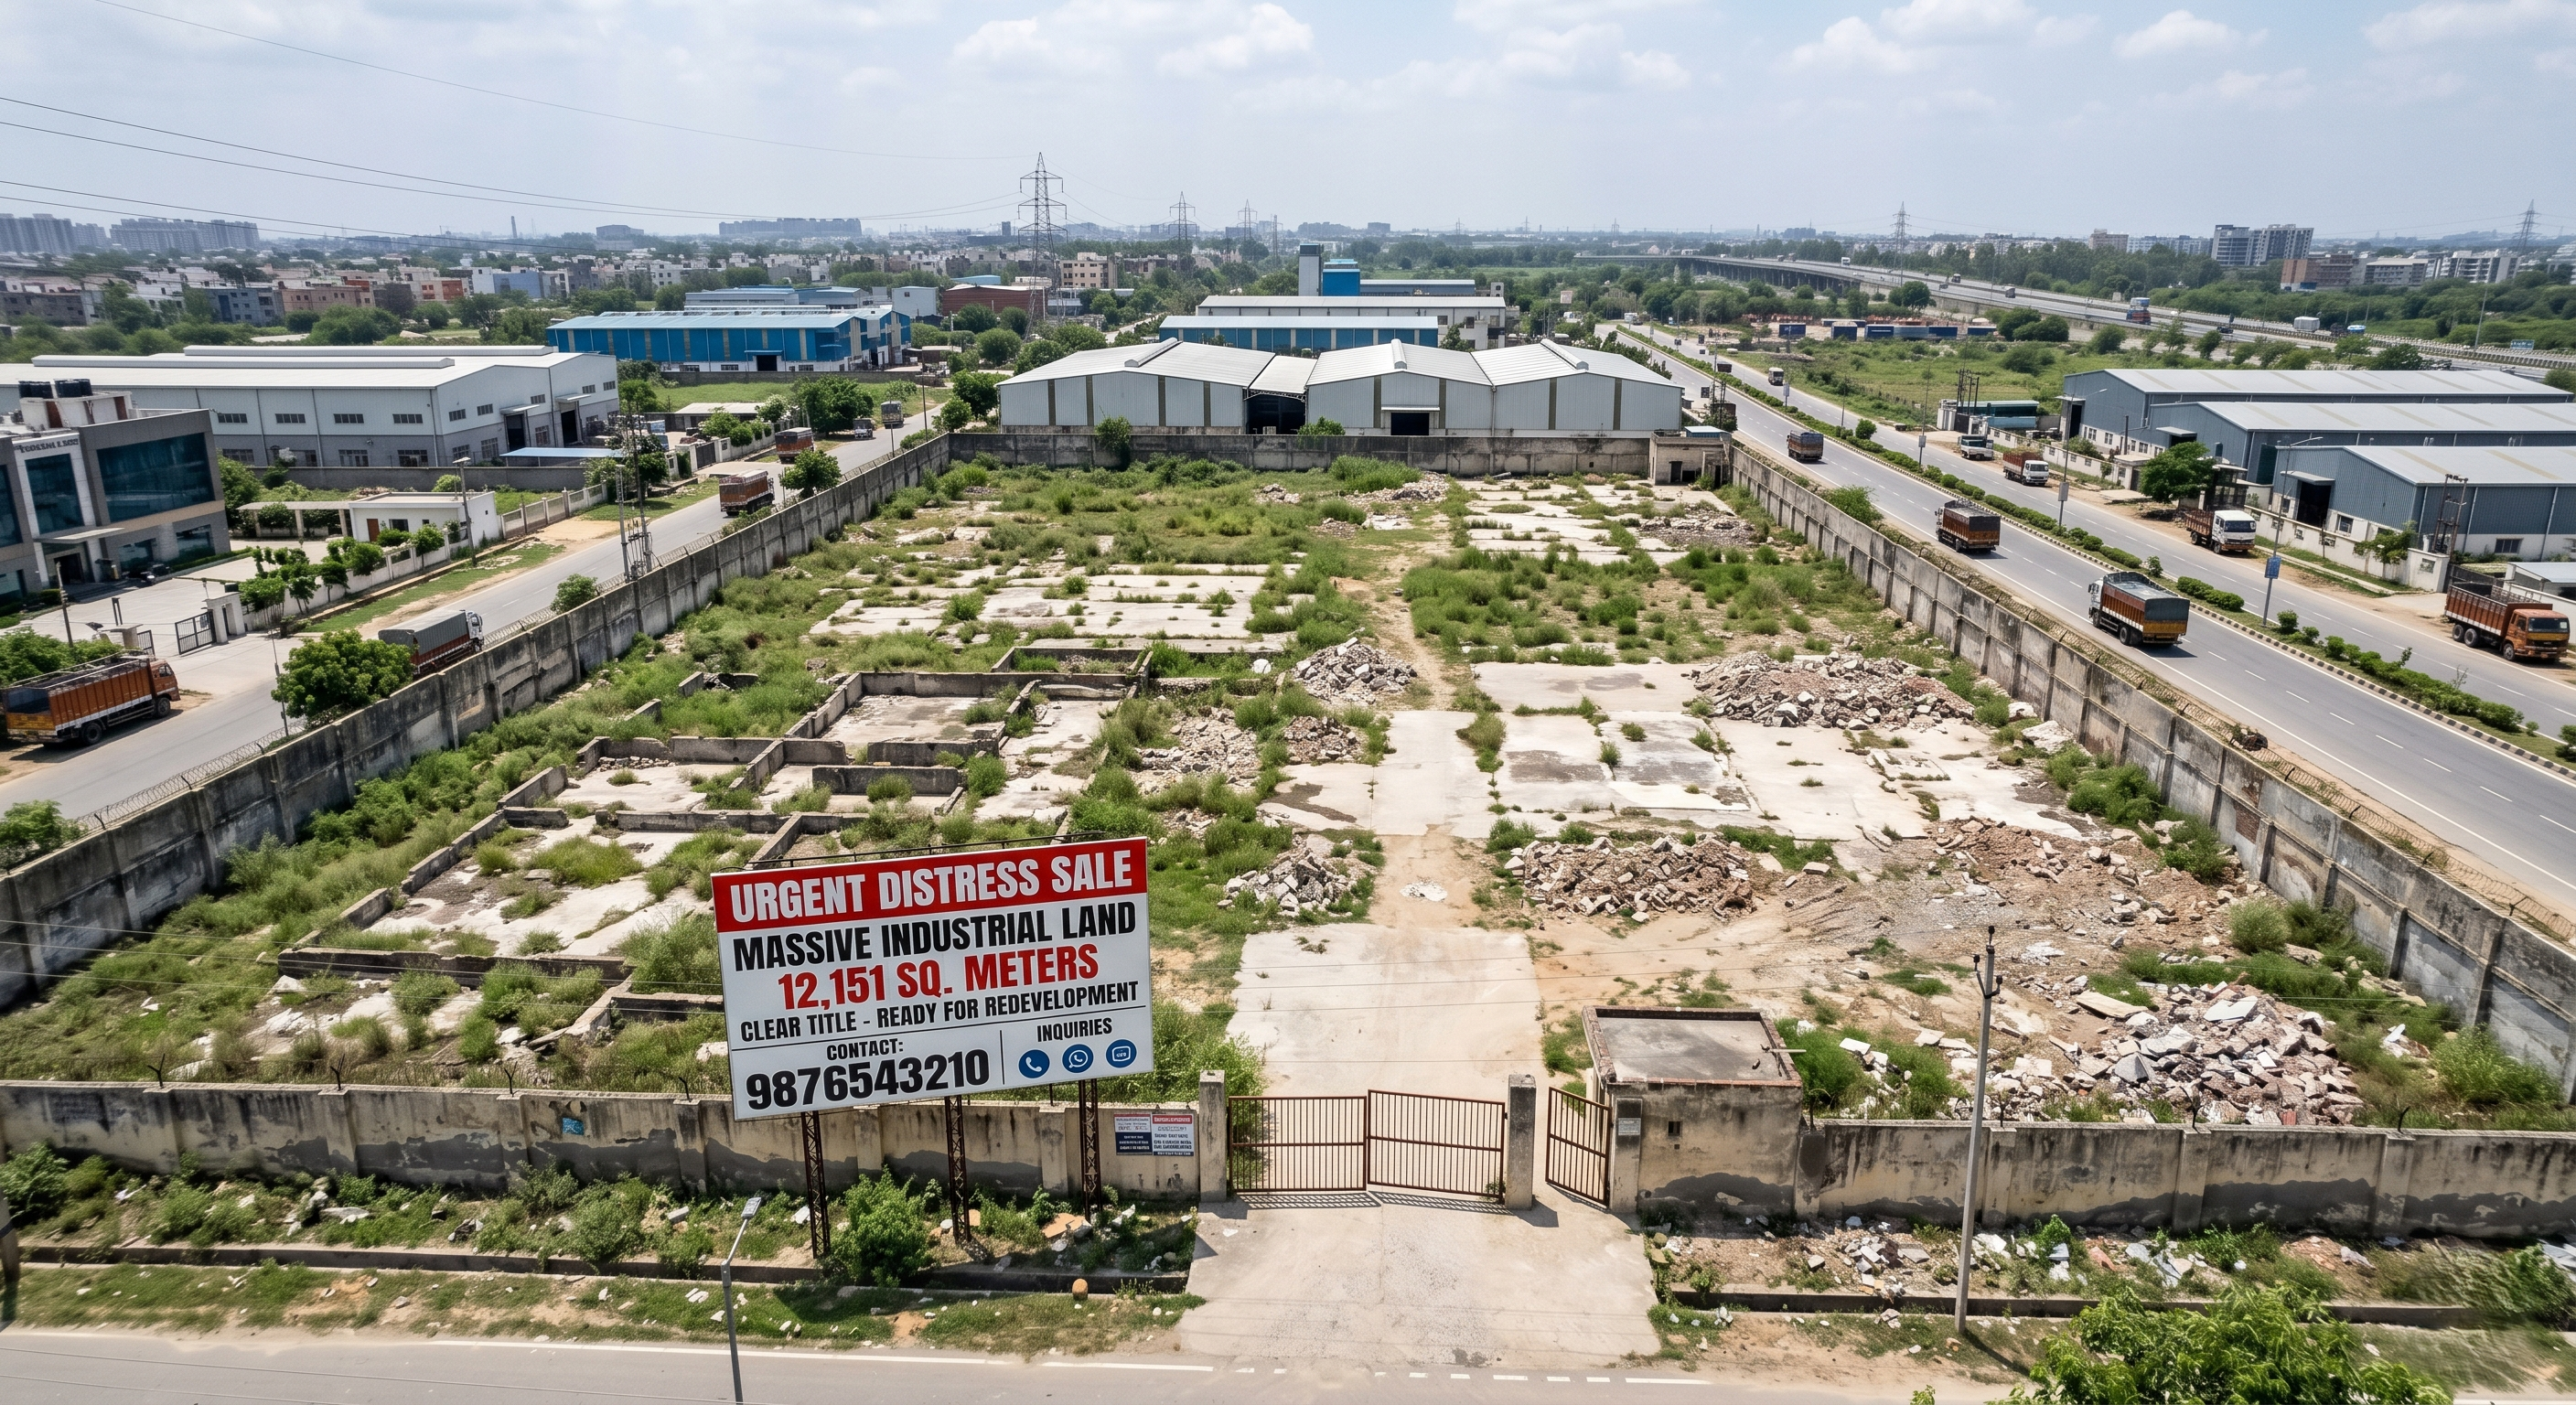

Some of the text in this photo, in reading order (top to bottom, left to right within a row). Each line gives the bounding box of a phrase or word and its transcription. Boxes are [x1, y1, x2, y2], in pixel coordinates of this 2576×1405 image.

[731, 850, 1132, 922] URGENT DISTRESS SALE
[734, 902, 1135, 971] MASSIVE INDUSTRIAL LAND
[778, 944, 1098, 1010] 12,151 SQ. METERS
[741, 1017, 800, 1042] CLEAR
[807, 1011, 856, 1035] TITLE
[877, 1003, 936, 1028] READY
[944, 999, 978, 1021] FOR
[985, 981, 1138, 1016] REDEVELOPMENT
[1037, 1018, 1111, 1042] INQUIRIES
[746, 1049, 990, 1110] 9876543210
[827, 1038, 904, 1060] CONTACT:
